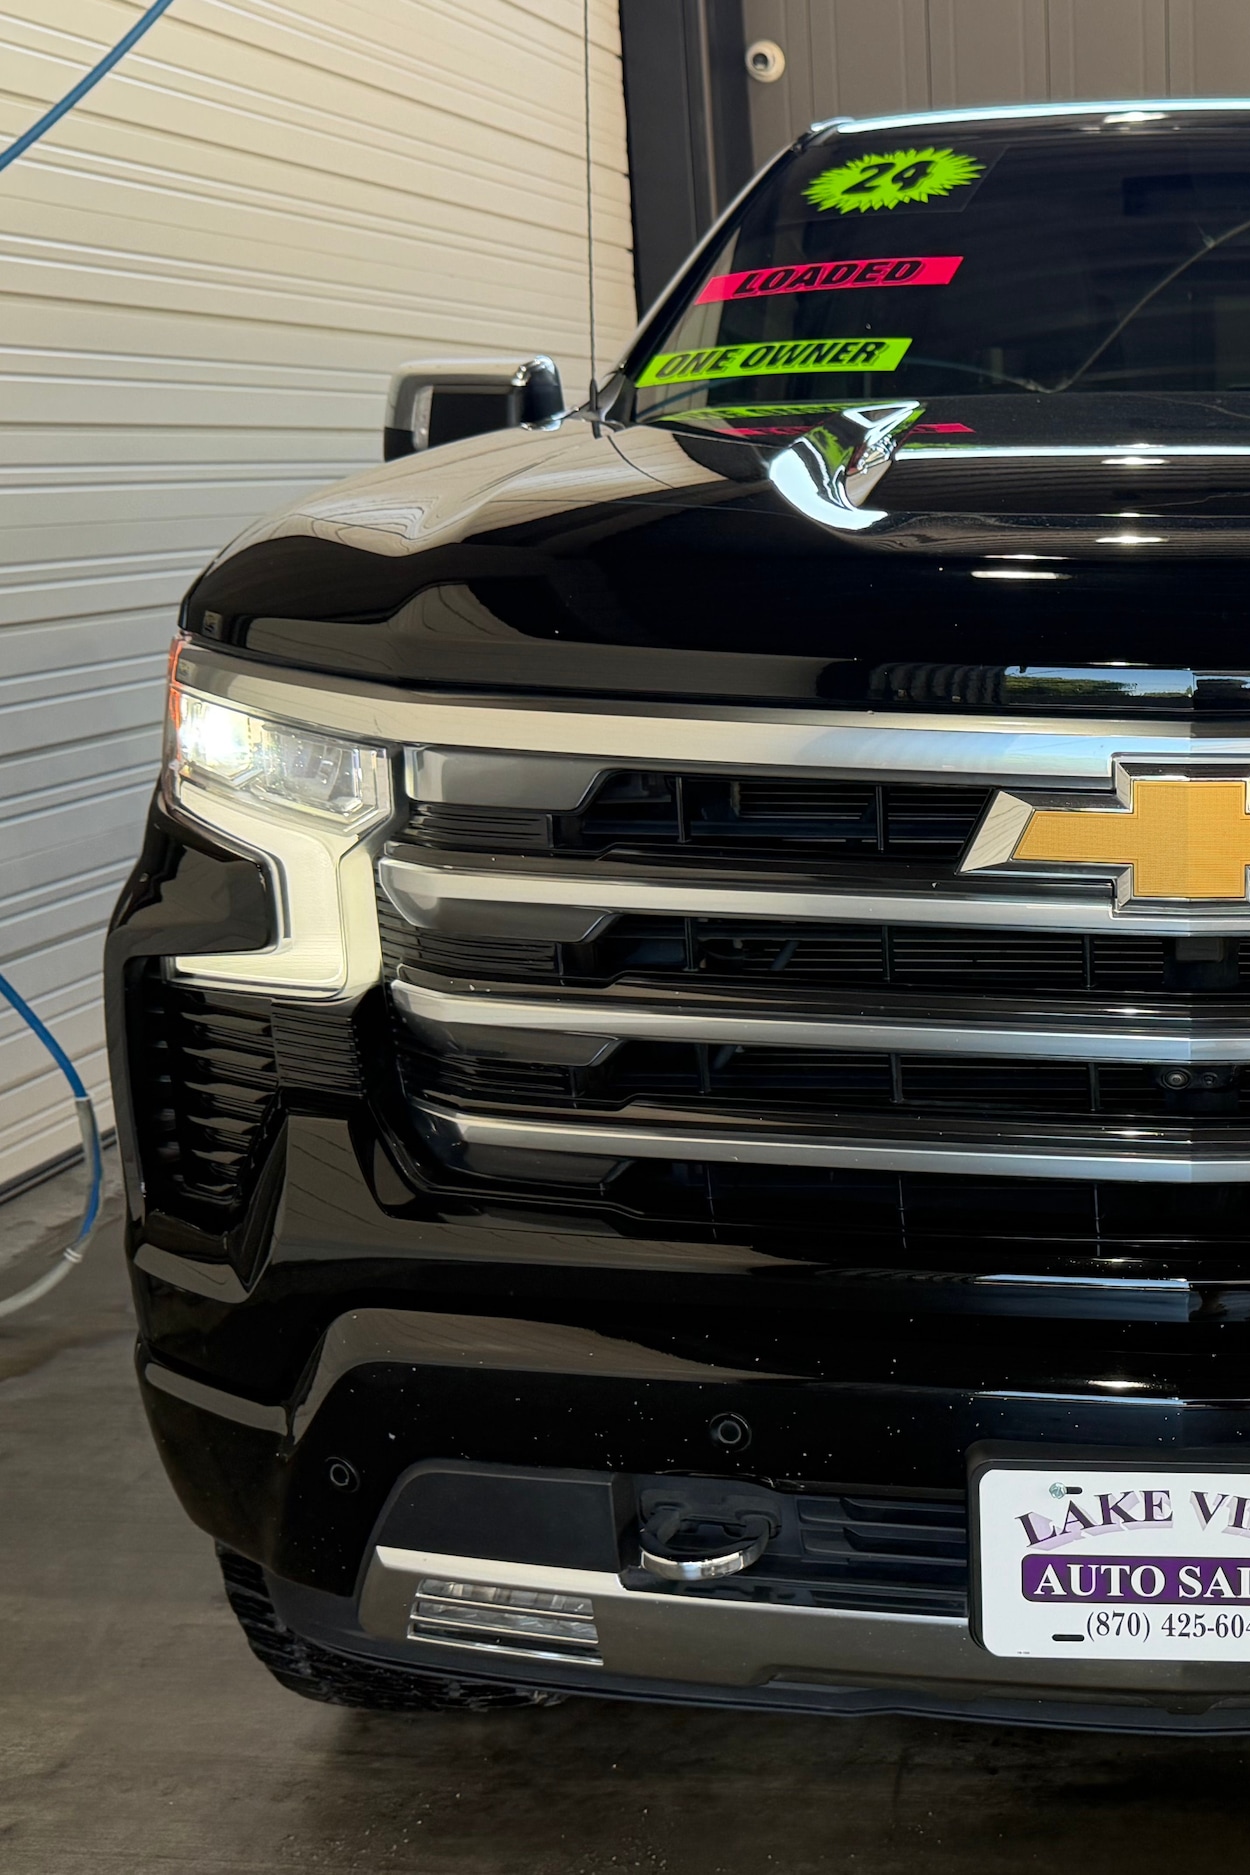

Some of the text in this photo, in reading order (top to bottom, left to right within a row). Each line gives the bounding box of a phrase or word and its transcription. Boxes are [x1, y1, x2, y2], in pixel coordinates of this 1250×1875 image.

[842, 160, 937, 194] 24
[733, 260, 924, 299] LOADED
[656, 341, 890, 380] ONE OWNER
[1015, 1489, 1174, 1550] LAKE
[1033, 1563, 1167, 1598] AUTO
[1086, 1611, 1151, 1643] (870)
